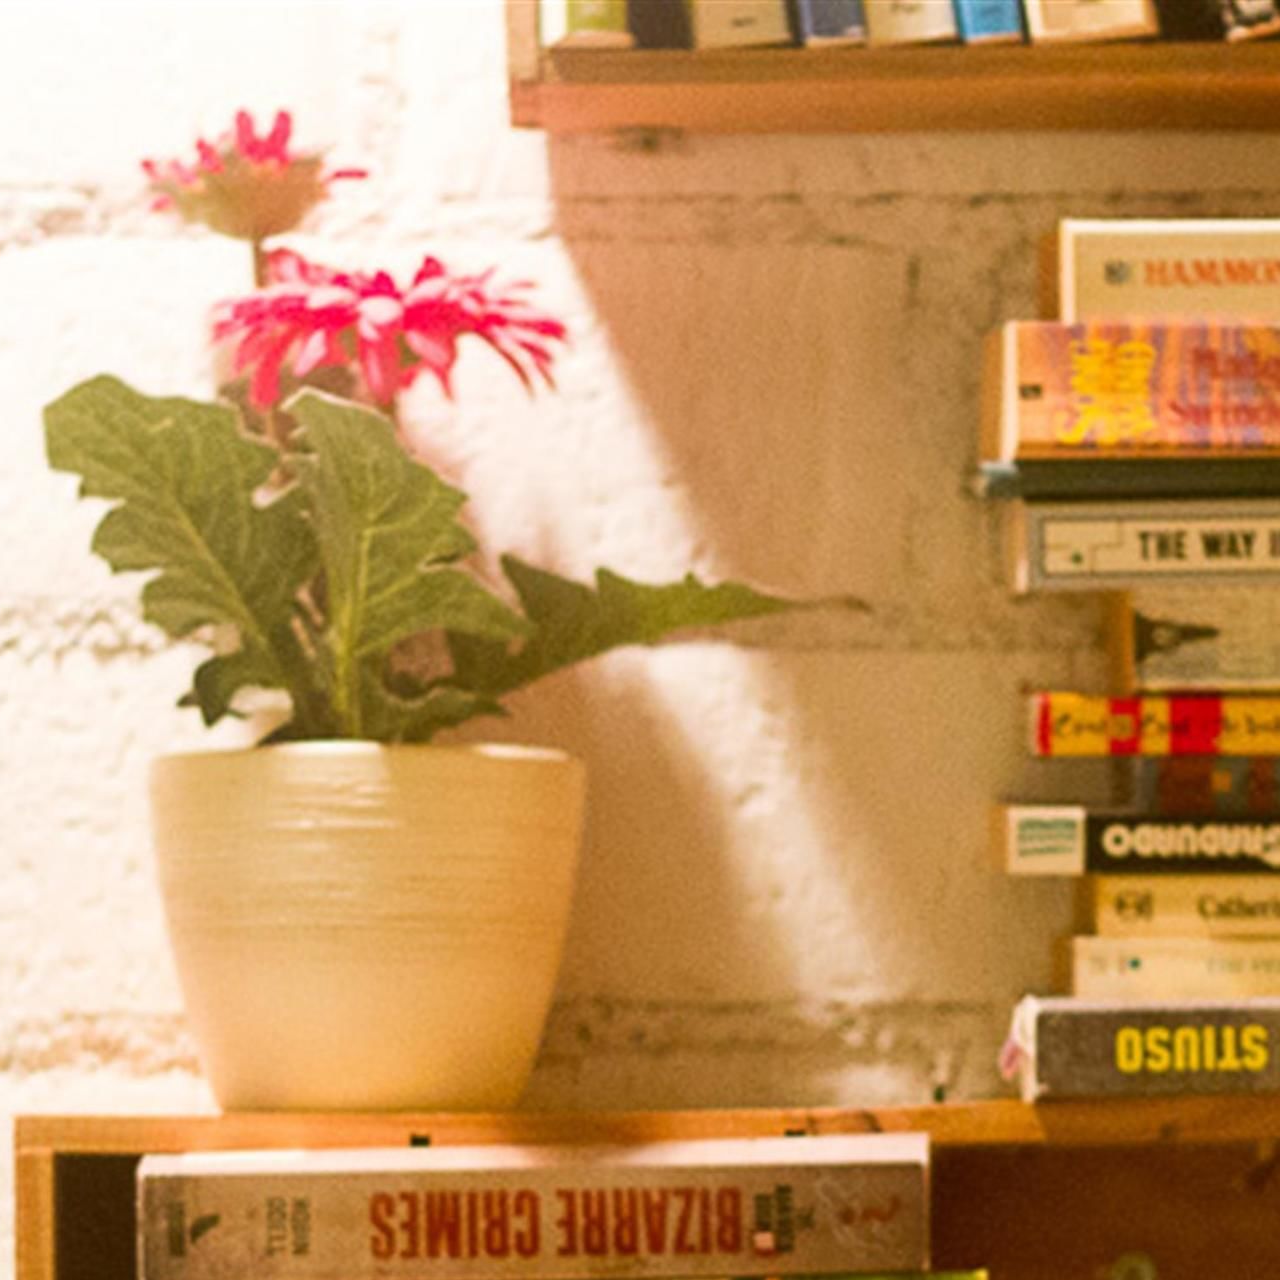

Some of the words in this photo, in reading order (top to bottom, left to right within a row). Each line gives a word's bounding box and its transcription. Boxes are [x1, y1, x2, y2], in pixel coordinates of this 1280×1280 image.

[1138, 532, 1192, 561] THE
[1199, 532, 1261, 560] WAY
[1116, 1023, 1270, 1074] STIUSO
[368, 1189, 543, 1260] CRIMES
[556, 1186, 743, 1260] BIZARRE
